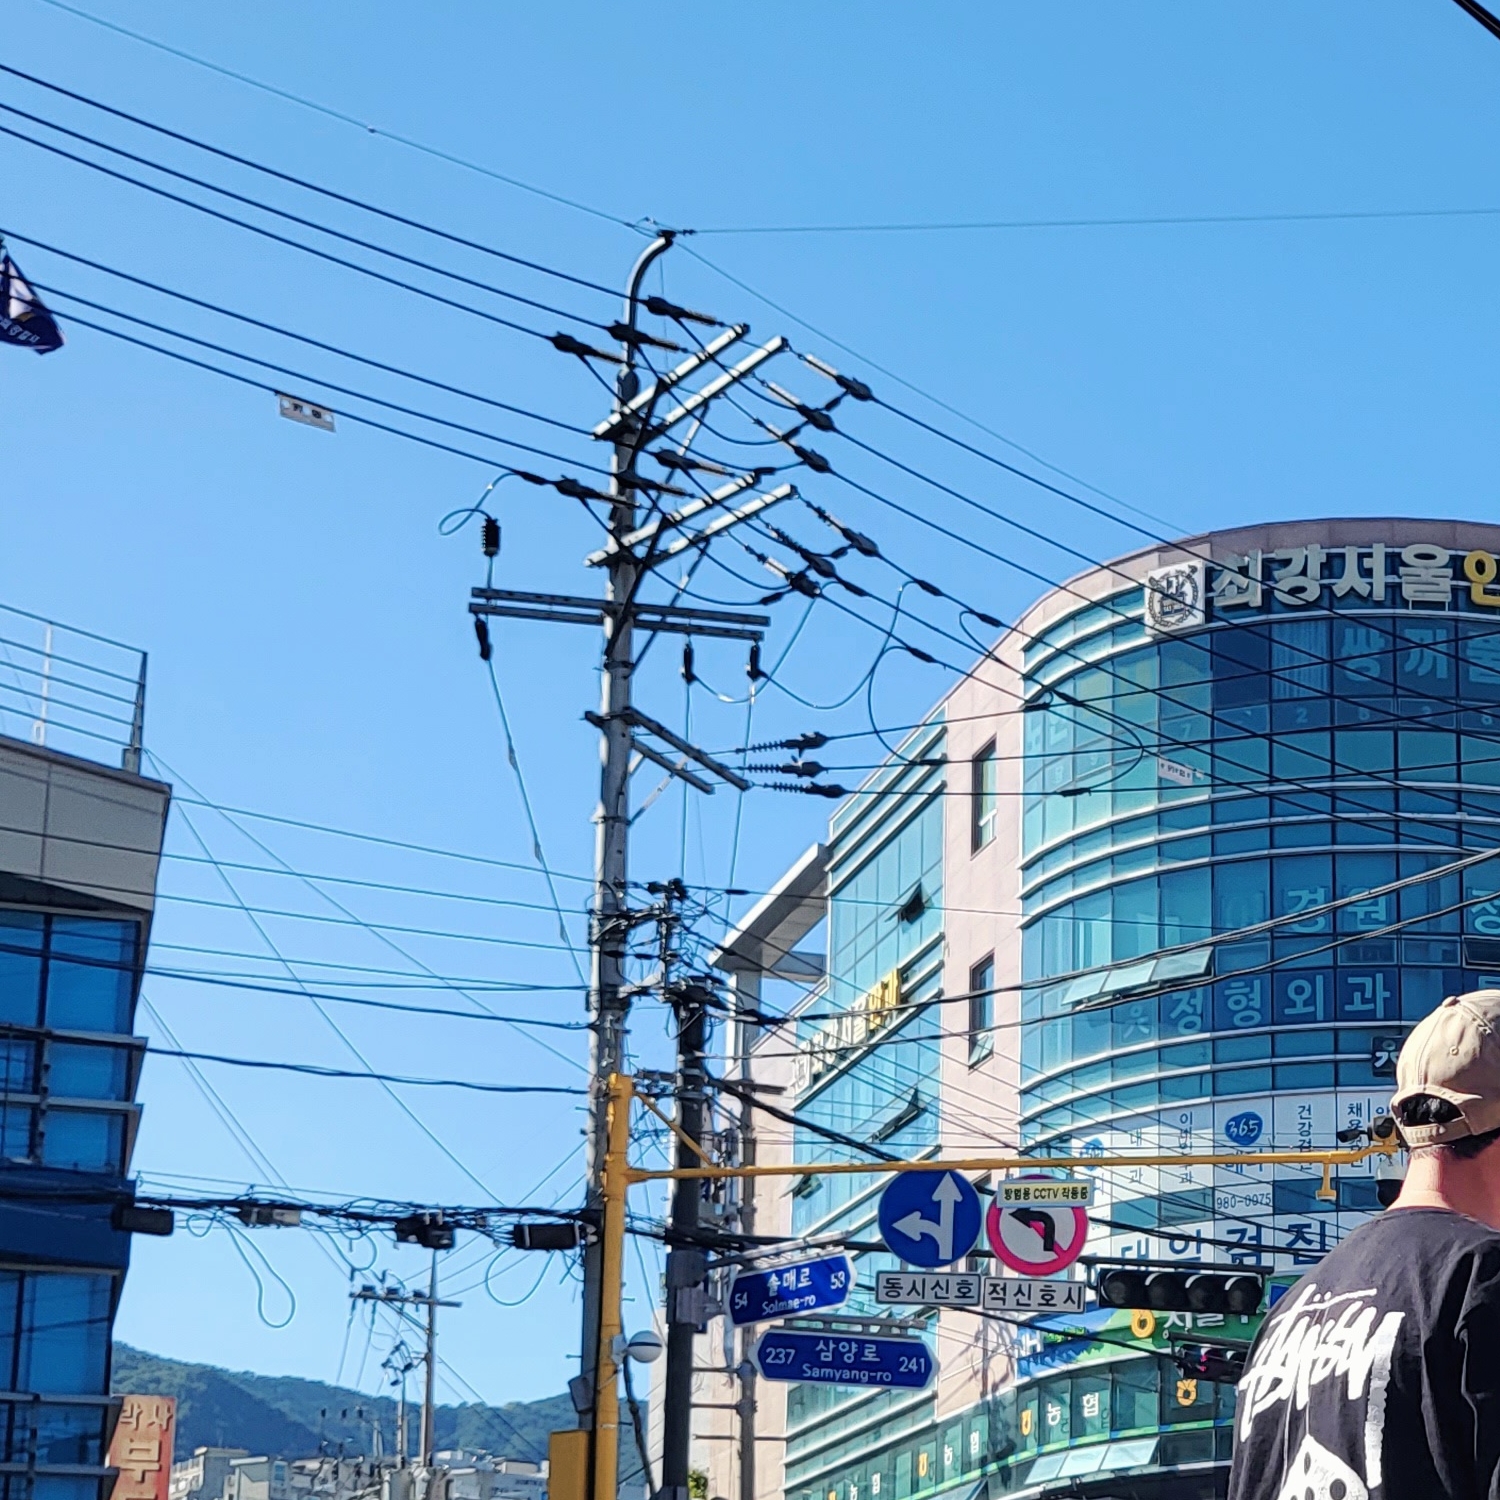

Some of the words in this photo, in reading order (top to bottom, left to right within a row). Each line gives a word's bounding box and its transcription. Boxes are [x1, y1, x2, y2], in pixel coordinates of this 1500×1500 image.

[1226, 1118, 1262, 1137] 365
[1033, 1187, 1060, 1200] CCTV
[1216, 1193, 1272, 1210] 980-0075
[766, 1268, 813, 1298] 솔매로
[882, 1276, 977, 1301] 동시신호
[734, 1291, 749, 1309] 54
[761, 1293, 817, 1316] Solmae-ro
[987, 1282, 1083, 1311] 적신호시
[765, 1347, 796, 1366] 237
[815, 1338, 881, 1364] 삼양로
[898, 1356, 927, 1375] 241
[801, 1363, 893, 1384] Samyang-ro
[1046, 1392, 1100, 1427] 농협
